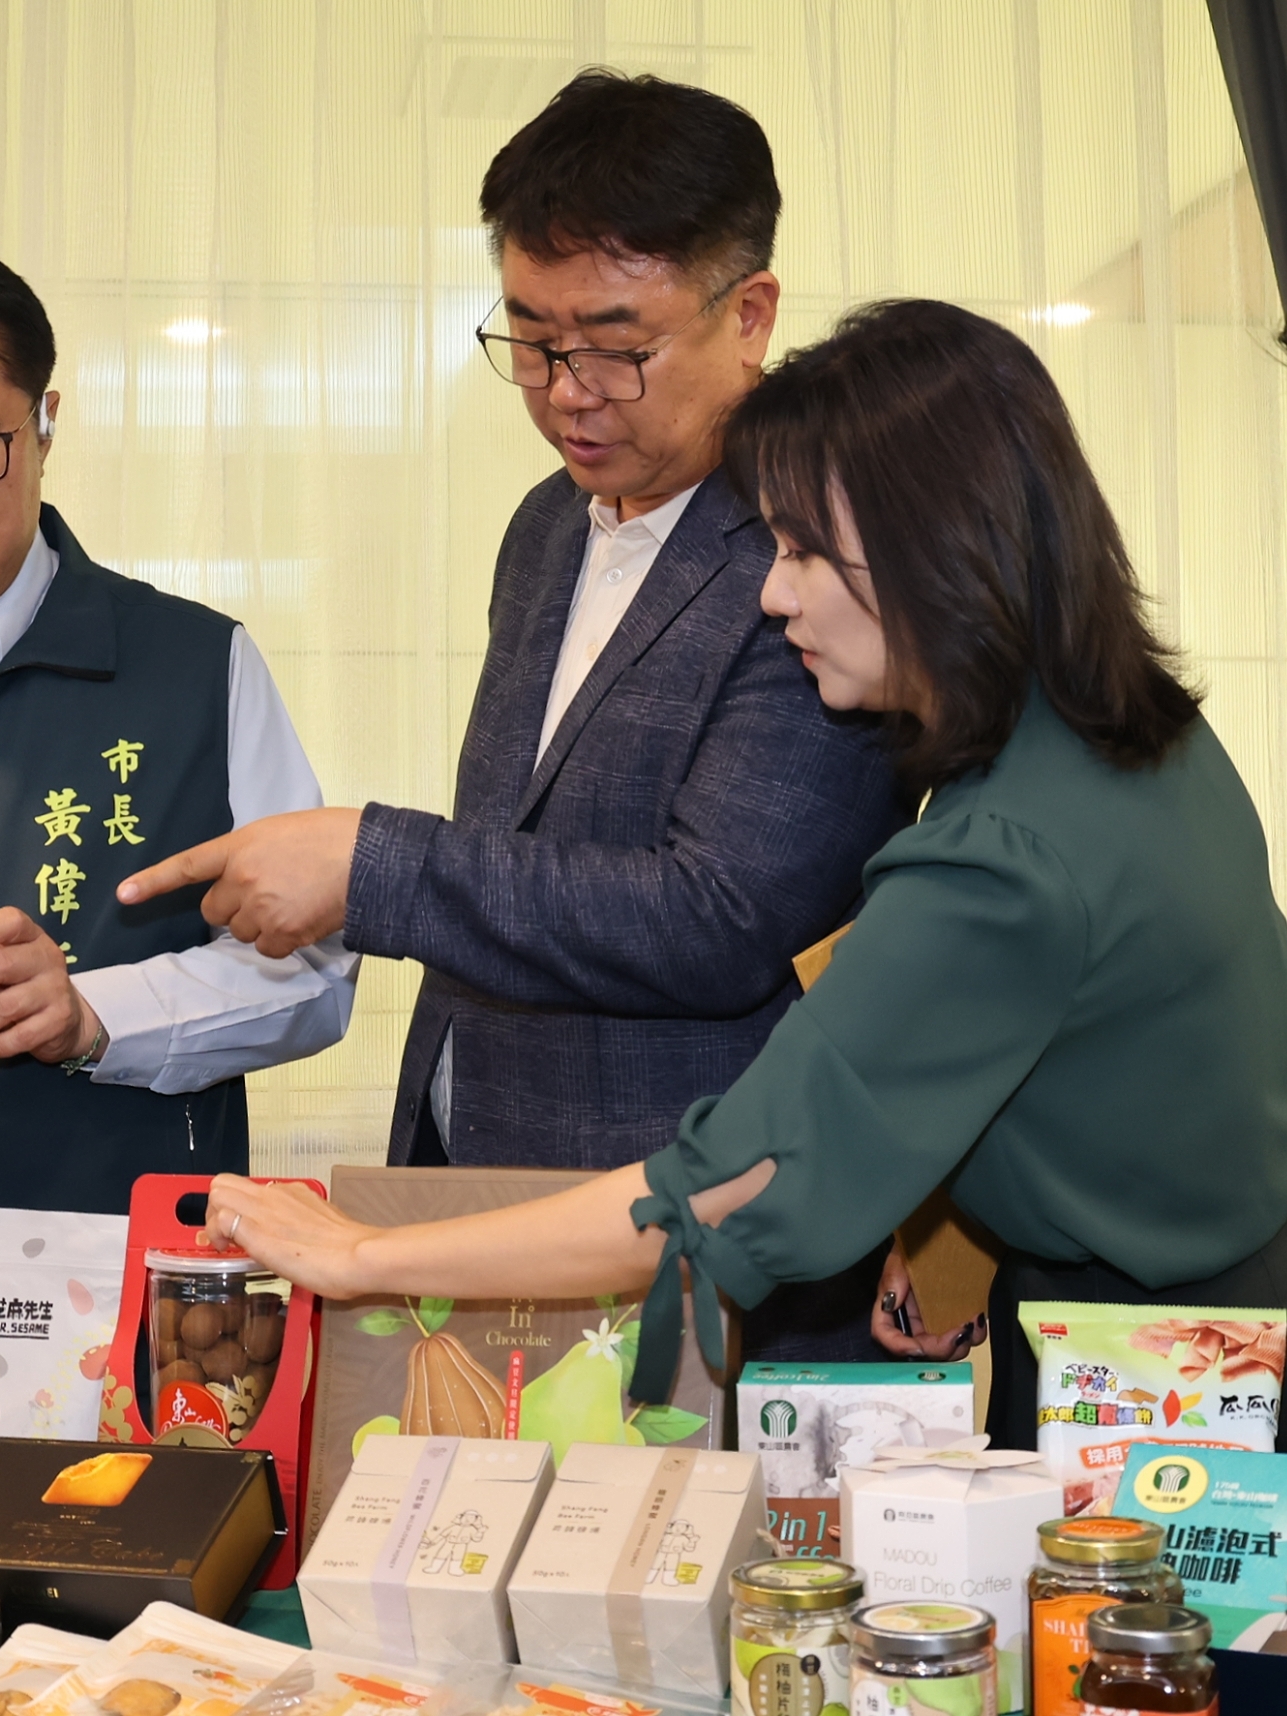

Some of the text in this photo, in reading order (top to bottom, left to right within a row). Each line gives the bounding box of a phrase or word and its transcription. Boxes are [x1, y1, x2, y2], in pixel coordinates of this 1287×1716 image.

[101, 739, 146, 845] 市長
[485, 1331, 552, 1348] Chocolate
[1219, 1393, 1276, 1416] 瓜瓜
[882, 1548, 938, 1567] MADOU
[874, 1571, 1013, 1599] Floral Drip Coffee
